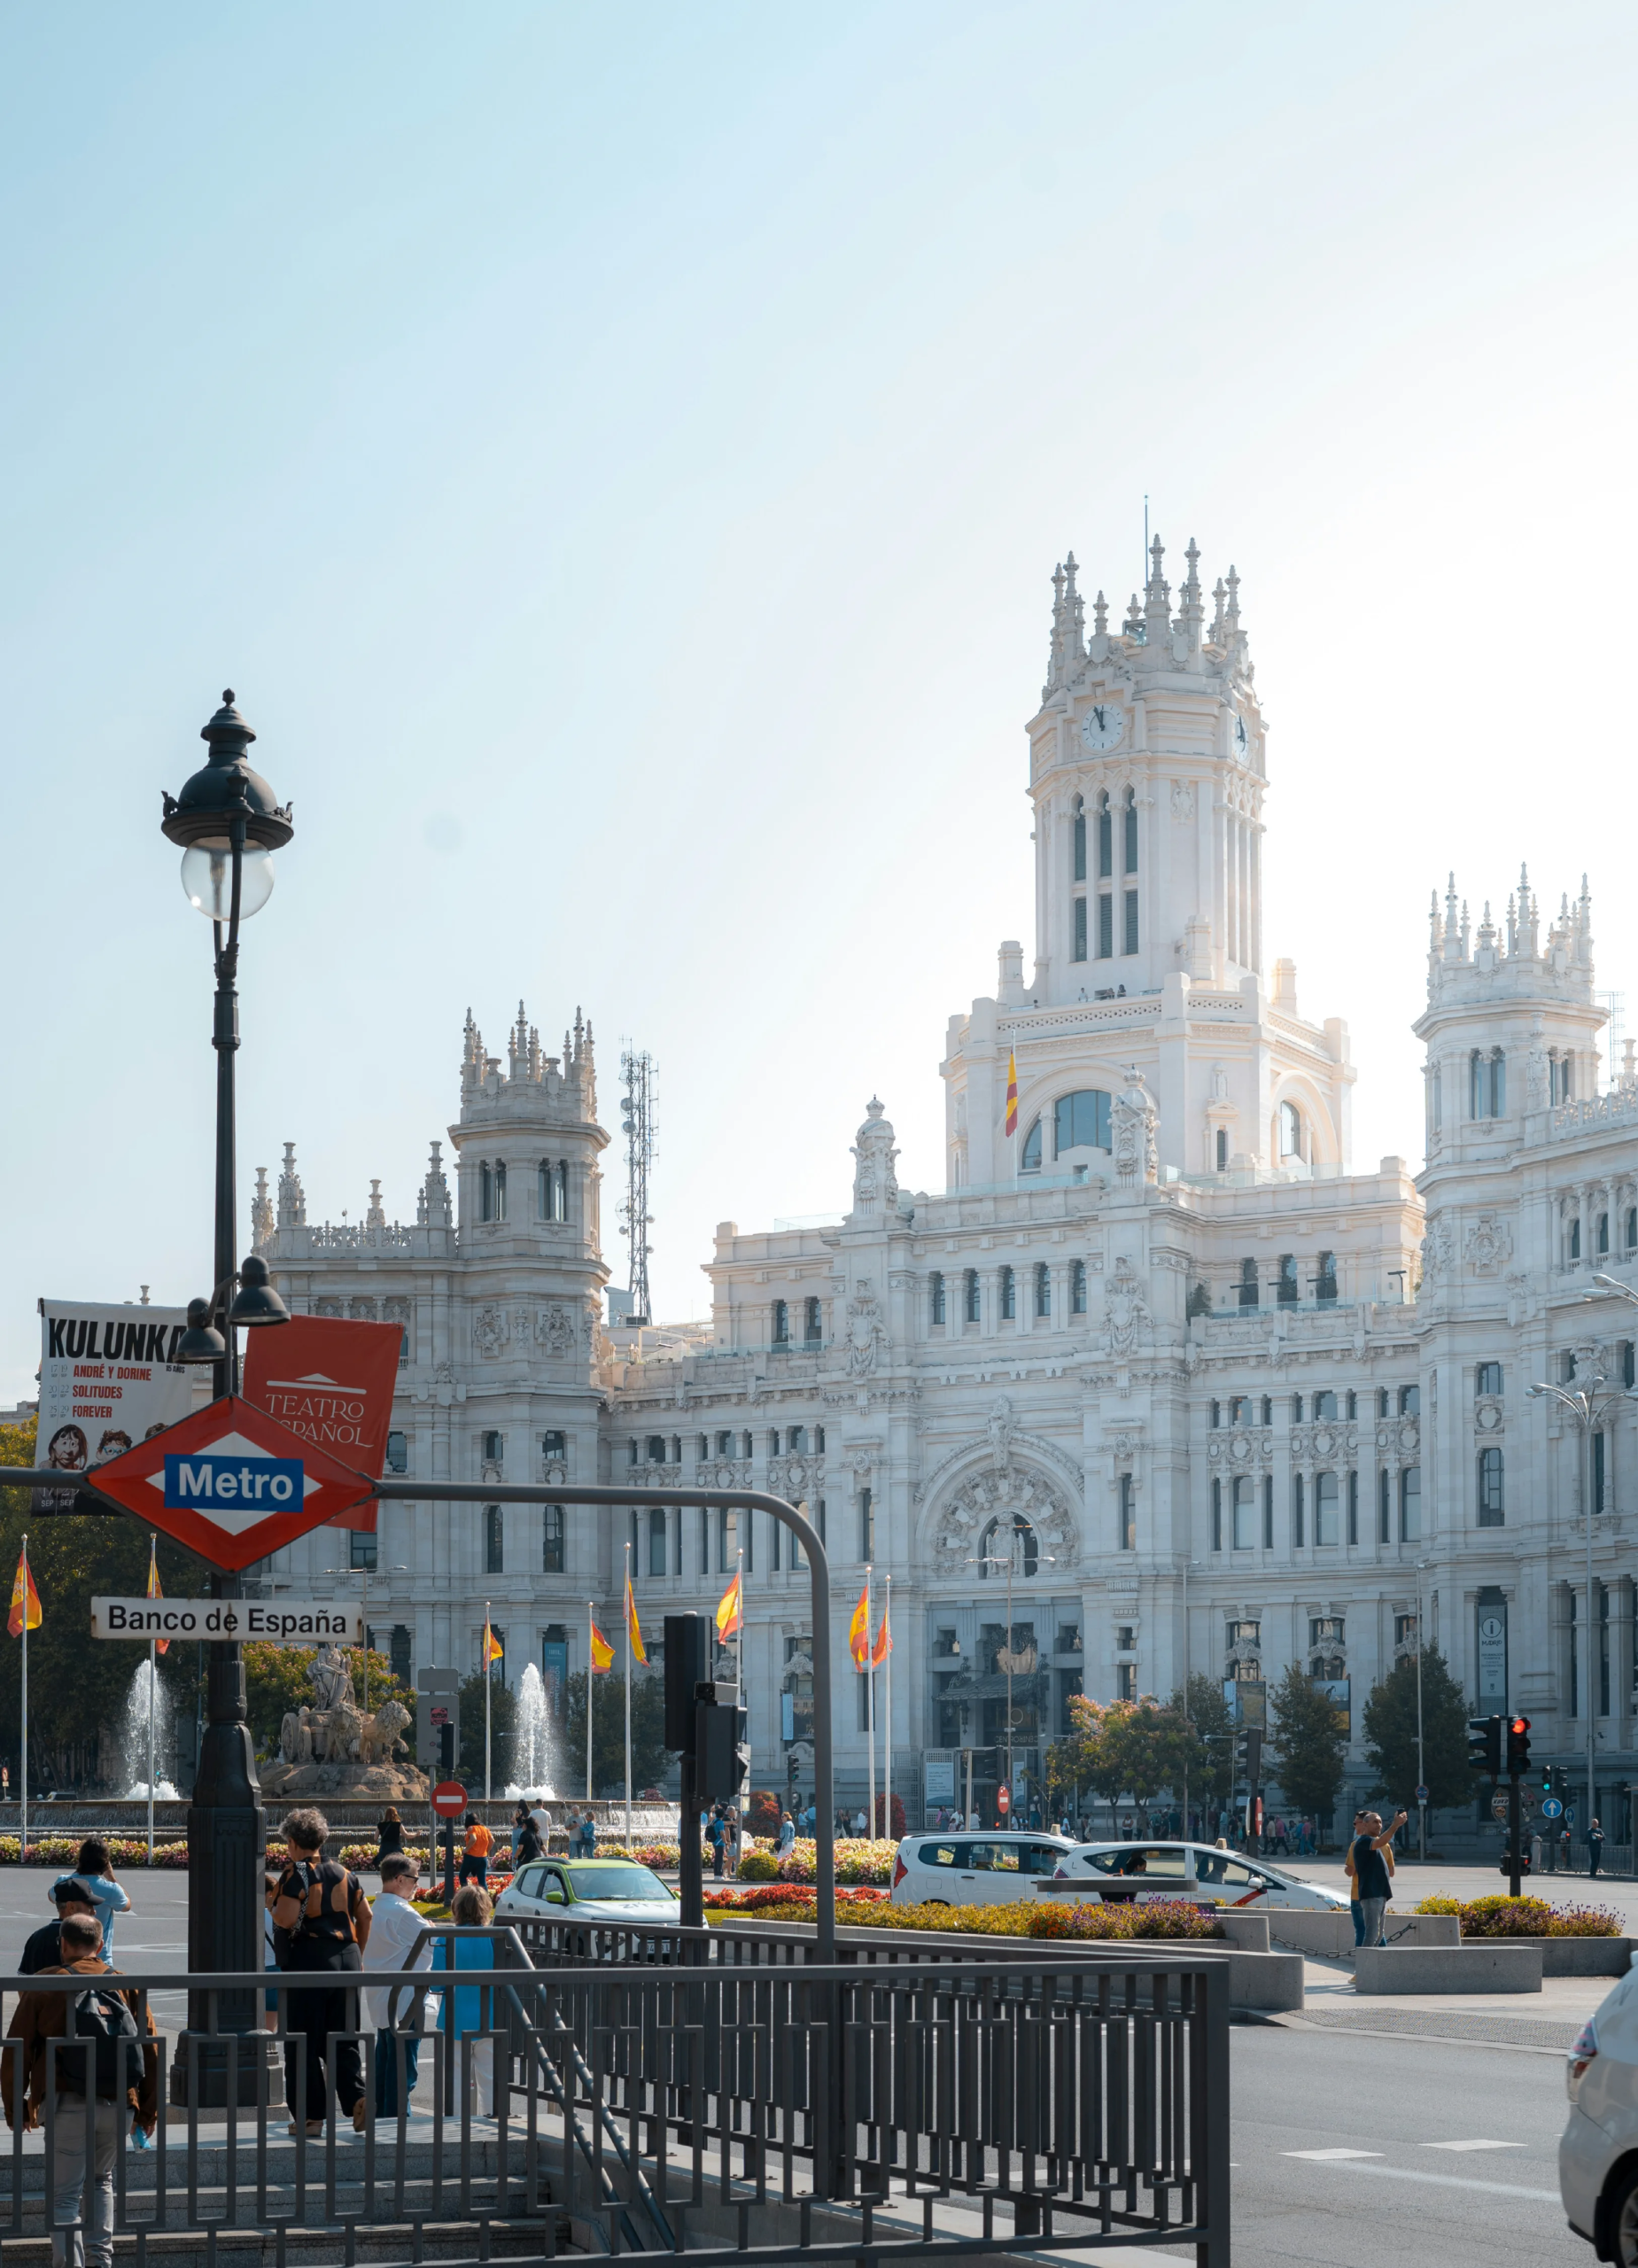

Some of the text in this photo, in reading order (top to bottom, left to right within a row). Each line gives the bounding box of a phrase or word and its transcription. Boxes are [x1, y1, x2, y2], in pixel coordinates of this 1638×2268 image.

[50, 1364, 68, 1373] 17 19
[73, 1363, 151, 1382] ANDRÉ Y DORINE
[48, 1385, 58, 1394] 20
[72, 1384, 122, 1399] SOLITUDES
[48, 1405, 69, 1414] 25 29
[72, 1405, 113, 1418] FOREVER
[266, 1394, 364, 1423] TEATRO
[279, 1419, 375, 1448] PAÑOL
[179, 1463, 293, 1501] Metro
[108, 1604, 346, 1638] Banco de España
